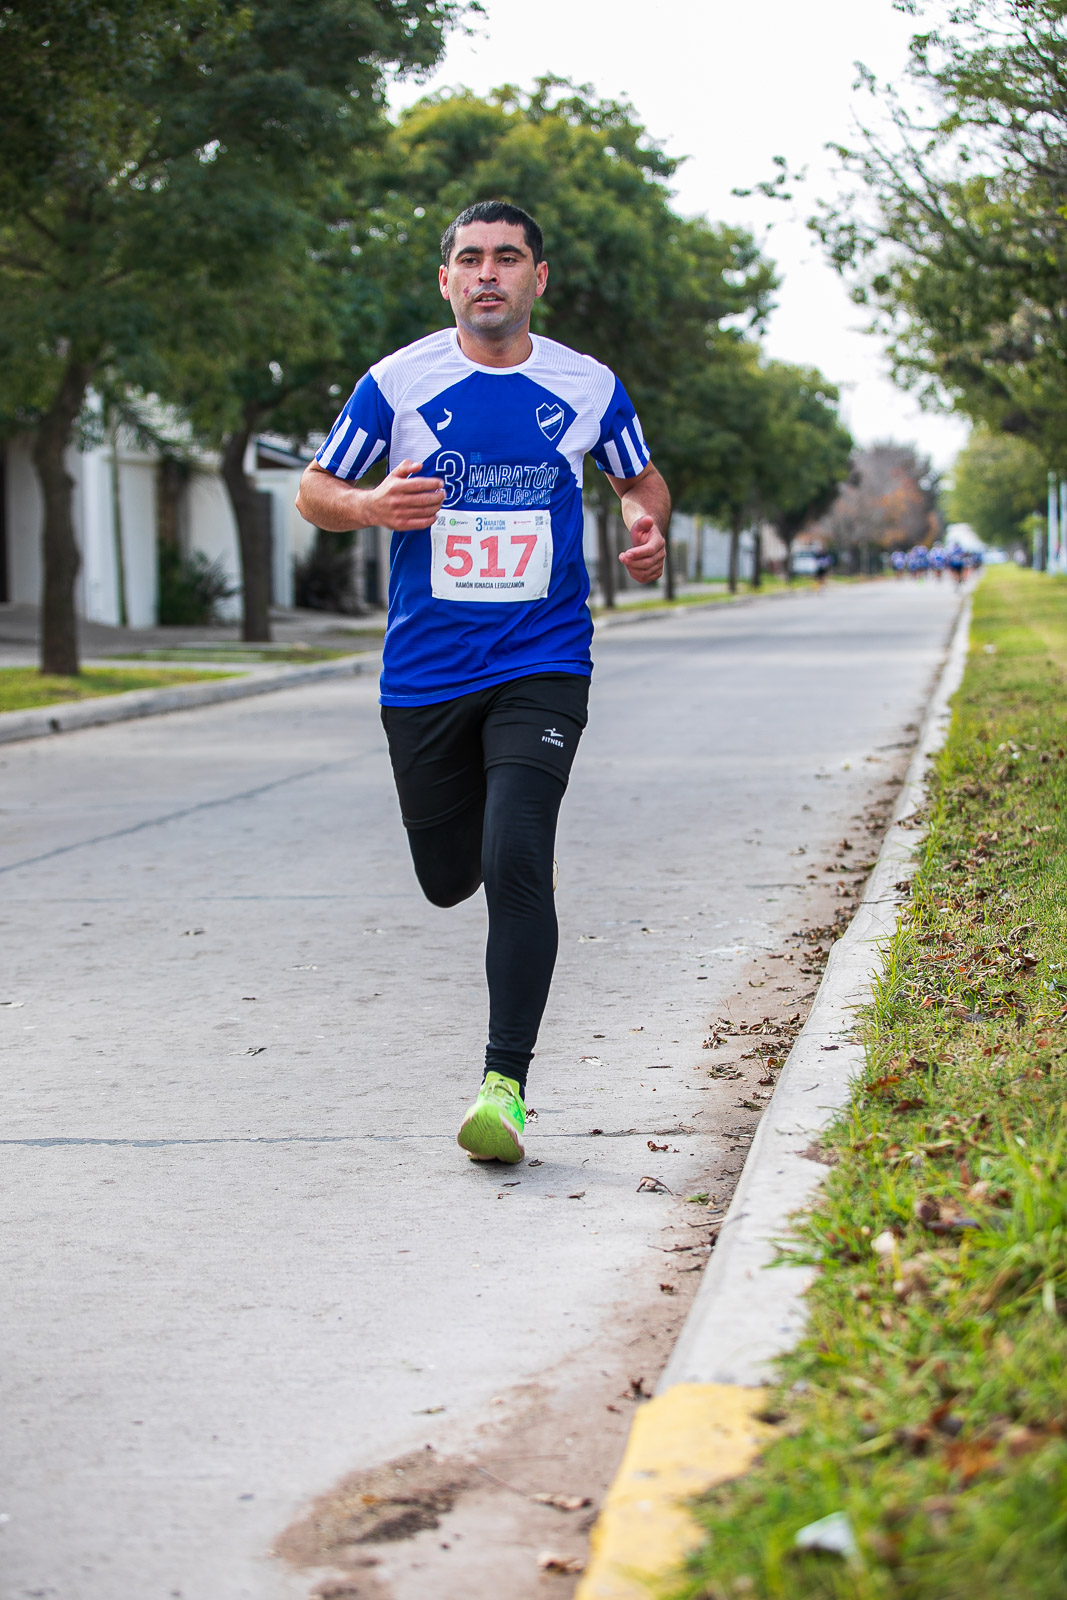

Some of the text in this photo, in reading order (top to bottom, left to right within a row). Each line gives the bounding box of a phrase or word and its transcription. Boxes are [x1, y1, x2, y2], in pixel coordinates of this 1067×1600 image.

[436, 450, 466, 508] 3
[468, 462, 559, 489] MARATÓN
[475, 516, 483, 532] 3
[443, 534, 538, 578] 517
[455, 581, 474, 589] RAMÓN
[494, 580, 525, 589] LEGUIZAMÓN
[541, 735, 564, 748] FITNESS
